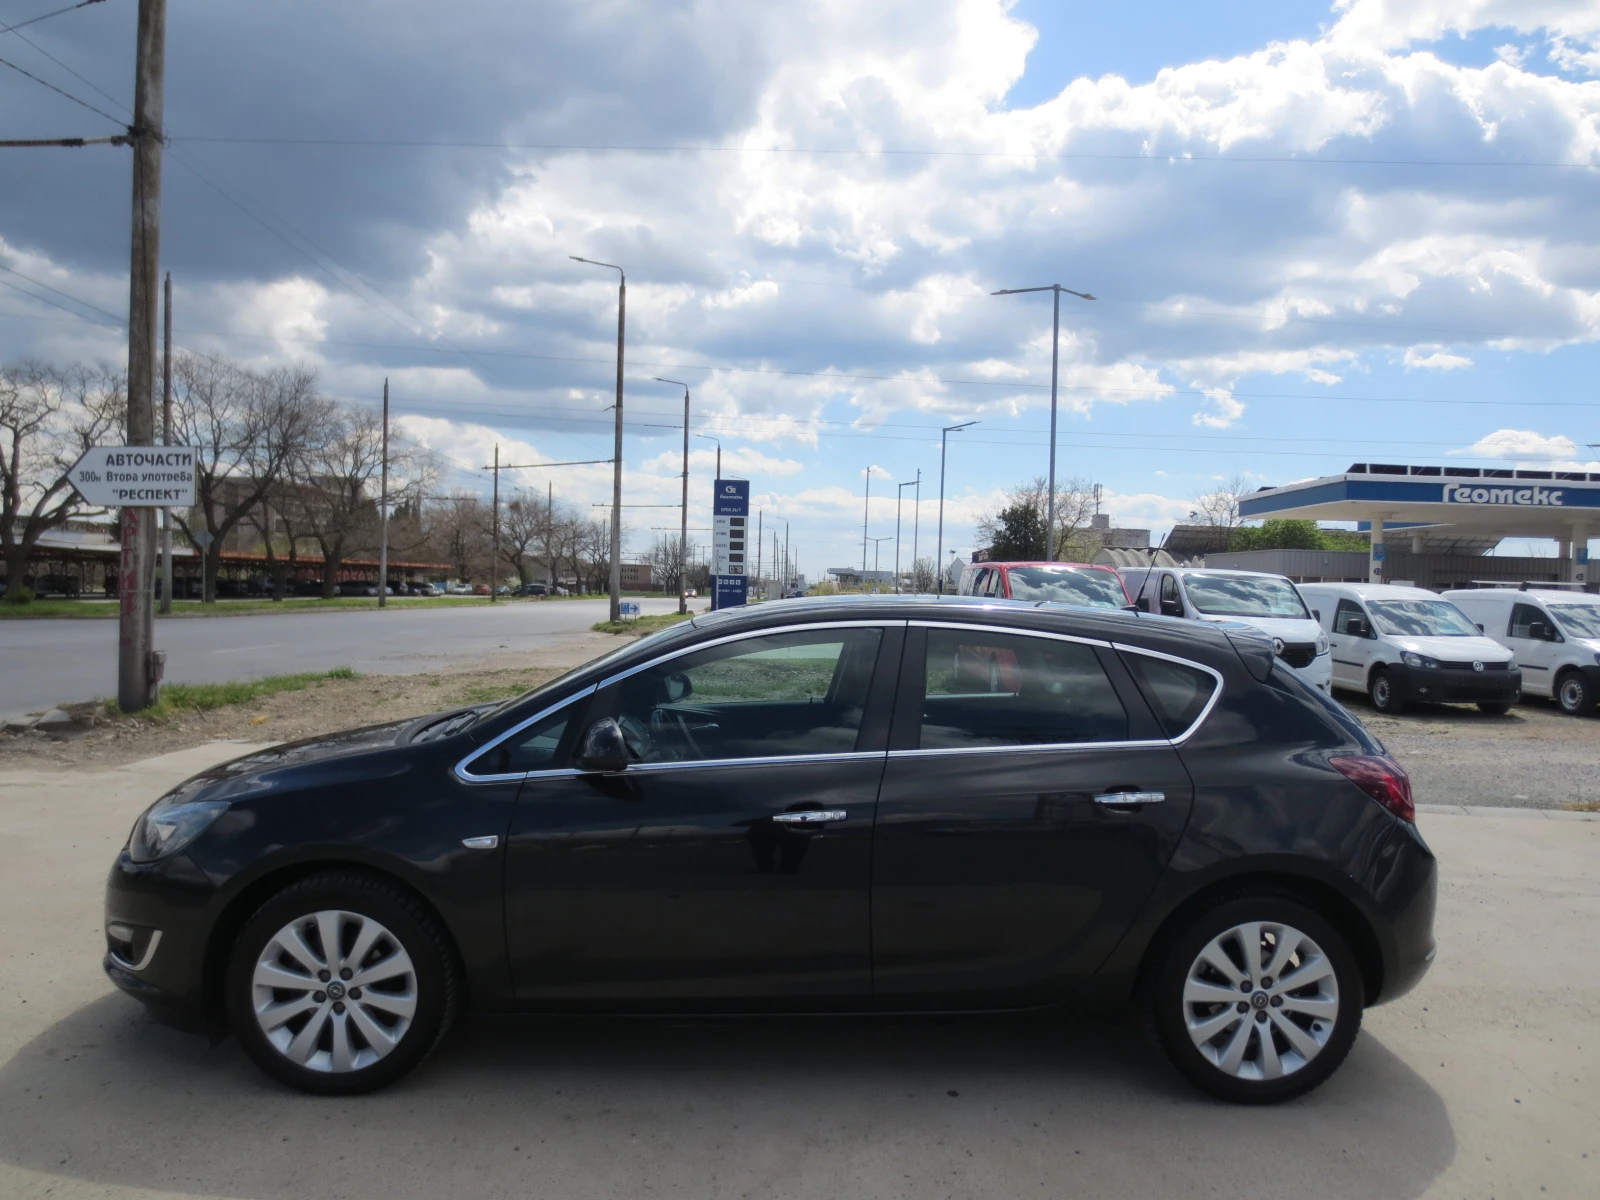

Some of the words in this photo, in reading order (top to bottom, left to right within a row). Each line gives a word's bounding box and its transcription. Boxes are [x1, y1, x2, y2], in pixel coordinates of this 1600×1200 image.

[106, 453, 192, 466] АВТОЧАСТИ
[106, 472, 139, 482] Втора
[141, 471, 193, 482] употреба
[1443, 484, 1563, 505] Геомекс
